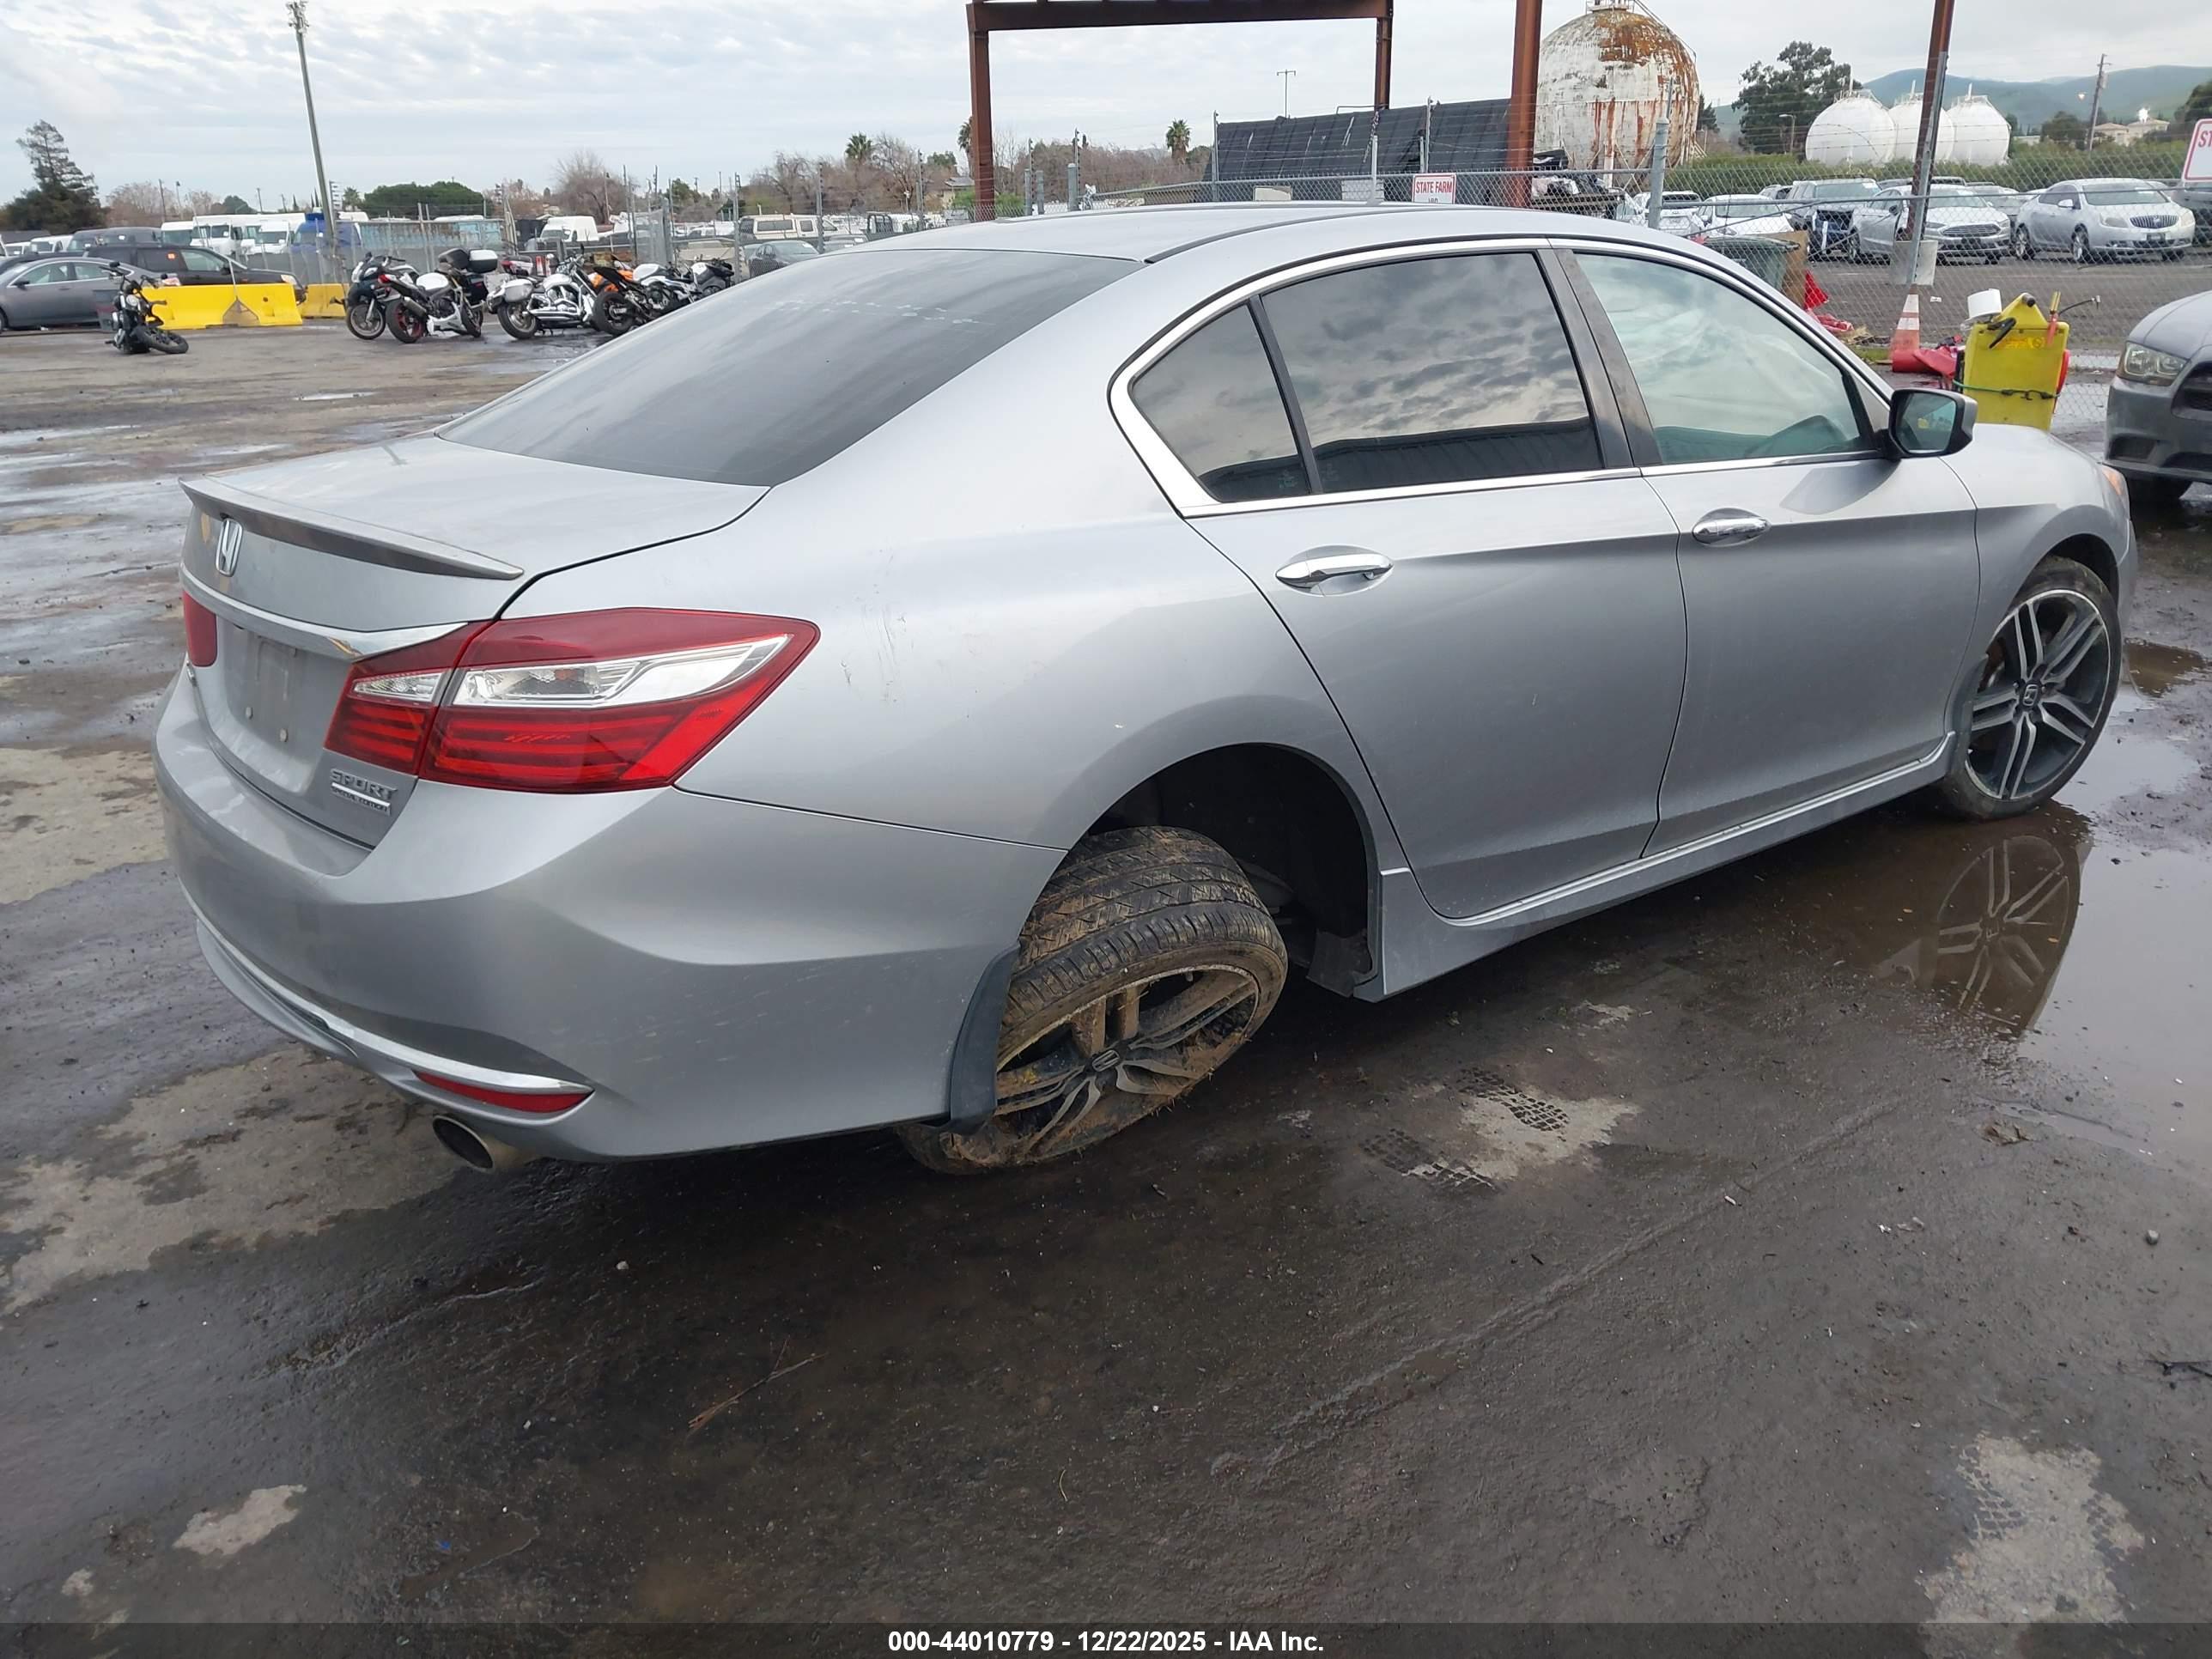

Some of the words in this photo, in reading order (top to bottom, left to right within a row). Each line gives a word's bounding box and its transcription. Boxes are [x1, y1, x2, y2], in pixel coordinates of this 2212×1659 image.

[1416, 181, 1434, 193] STATE
[1435, 181, 1453, 193] FARM
[330, 769, 398, 799] SPORT
